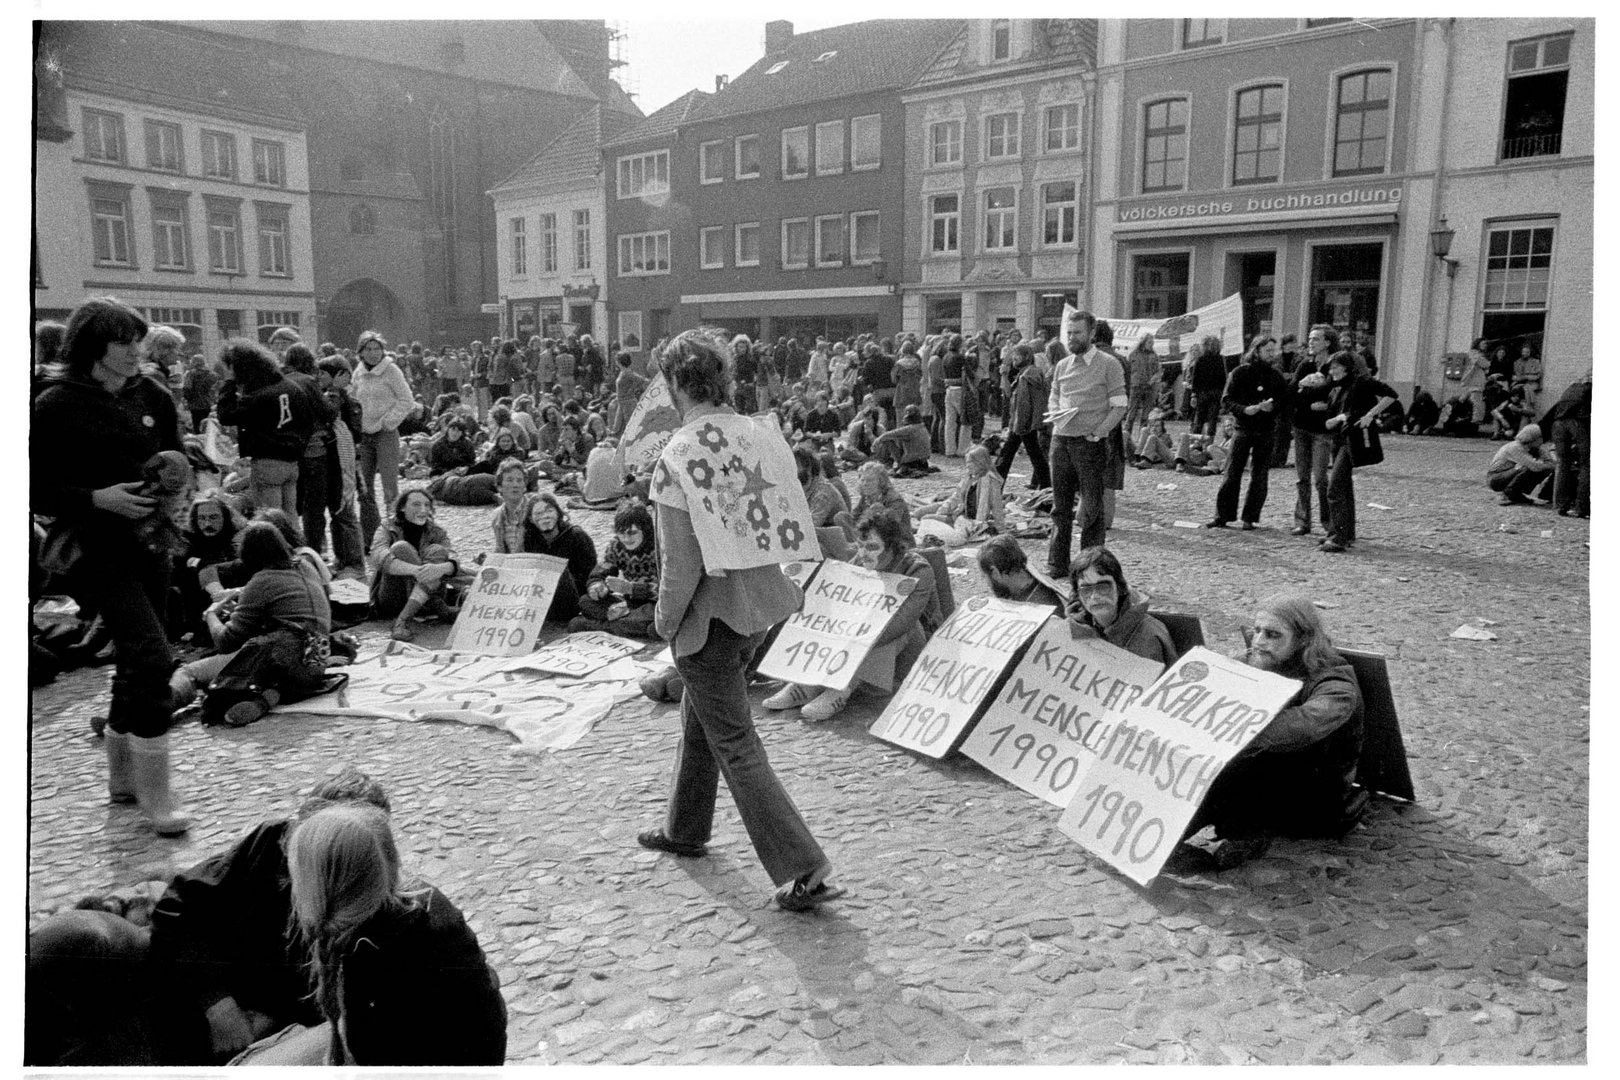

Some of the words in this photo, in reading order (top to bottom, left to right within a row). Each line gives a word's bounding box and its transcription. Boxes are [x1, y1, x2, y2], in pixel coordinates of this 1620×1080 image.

[1121, 201, 1233, 220] völckersche
[1246, 187, 1403, 212] buchhandlung
[469, 604, 536, 623] MENSCH
[792, 612, 872, 637] MENSCH
[474, 627, 526, 648] 1990
[785, 640, 850, 676] 1990
[906, 654, 1000, 705] MENSCH
[1032, 640, 1144, 713] KALKAR
[887, 702, 951, 747] 1990
[989, 724, 1079, 793] 1990
[1100, 719, 1224, 808] MENSCH
[1078, 784, 1165, 864] 1990
